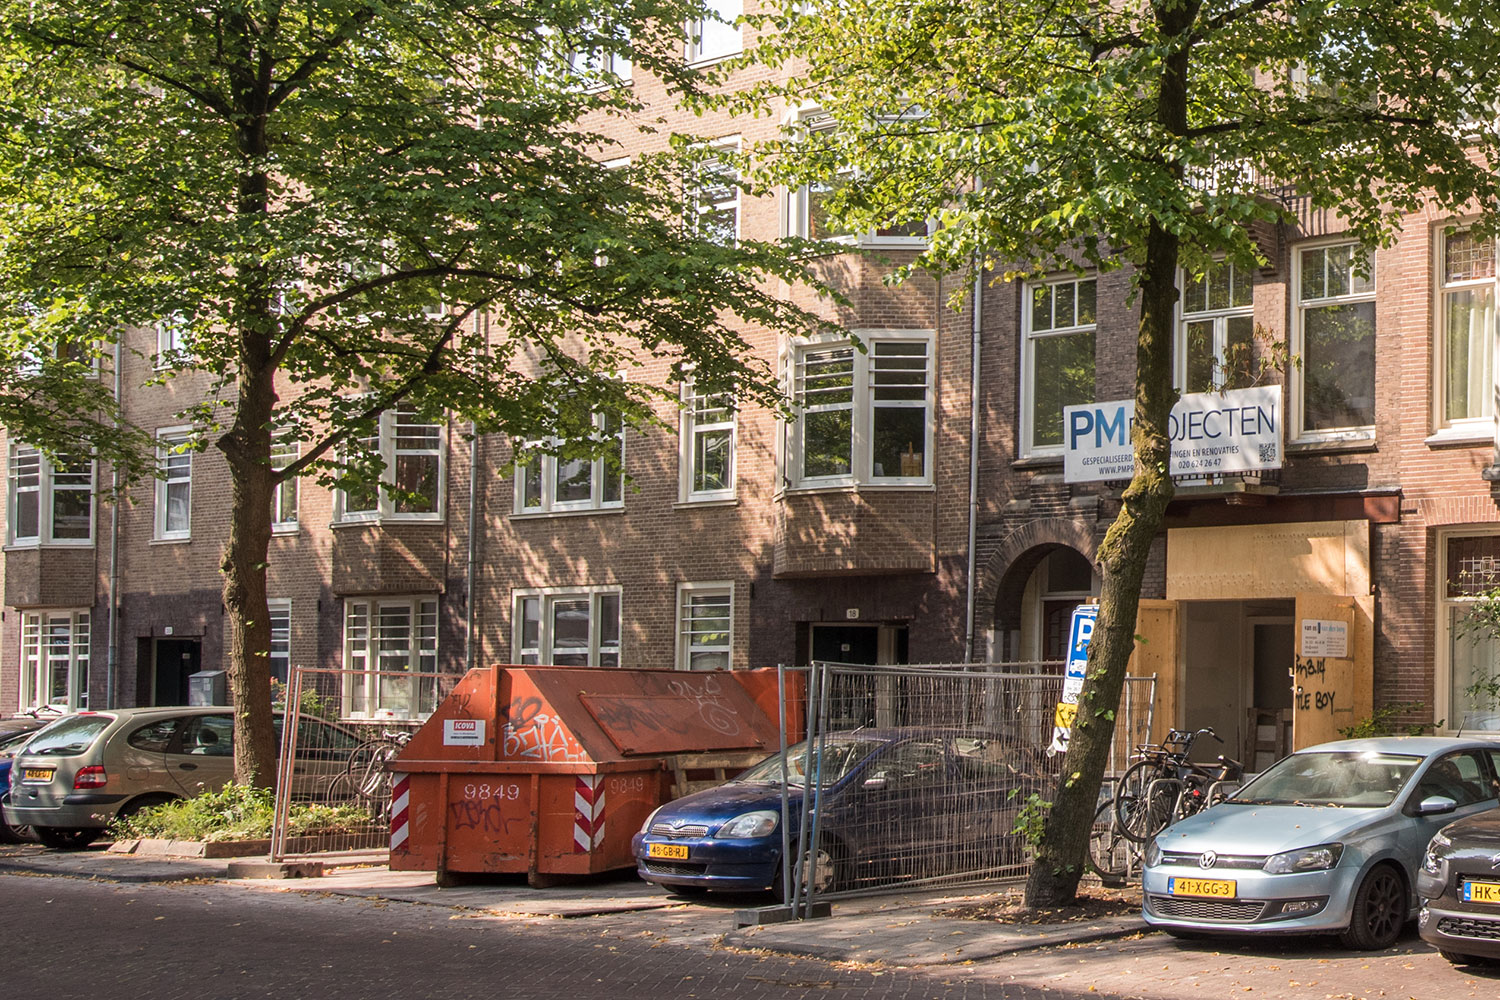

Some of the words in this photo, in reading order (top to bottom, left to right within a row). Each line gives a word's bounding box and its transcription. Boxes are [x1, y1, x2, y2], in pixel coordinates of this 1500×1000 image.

[1082, 454, 1133, 466] GESPECIALISEERD
[1193, 448, 1201, 457] EN
[1202, 445, 1240, 456] RENOVATIES
[1098, 465, 1135, 475] WWW.PMPR
[1178, 460, 1190, 469] 020
[1204, 458, 1213, 467] 26
[1213, 458, 1222, 466] 47
[1076, 618, 1095, 652] P
[1315, 691, 1336, 715] BOY
[455, 722, 475, 730] ICOVA
[464, 783, 520, 800] 9849
[610, 776, 644, 794] 9849
[1179, 881, 1230, 895] 41-XGG-3
